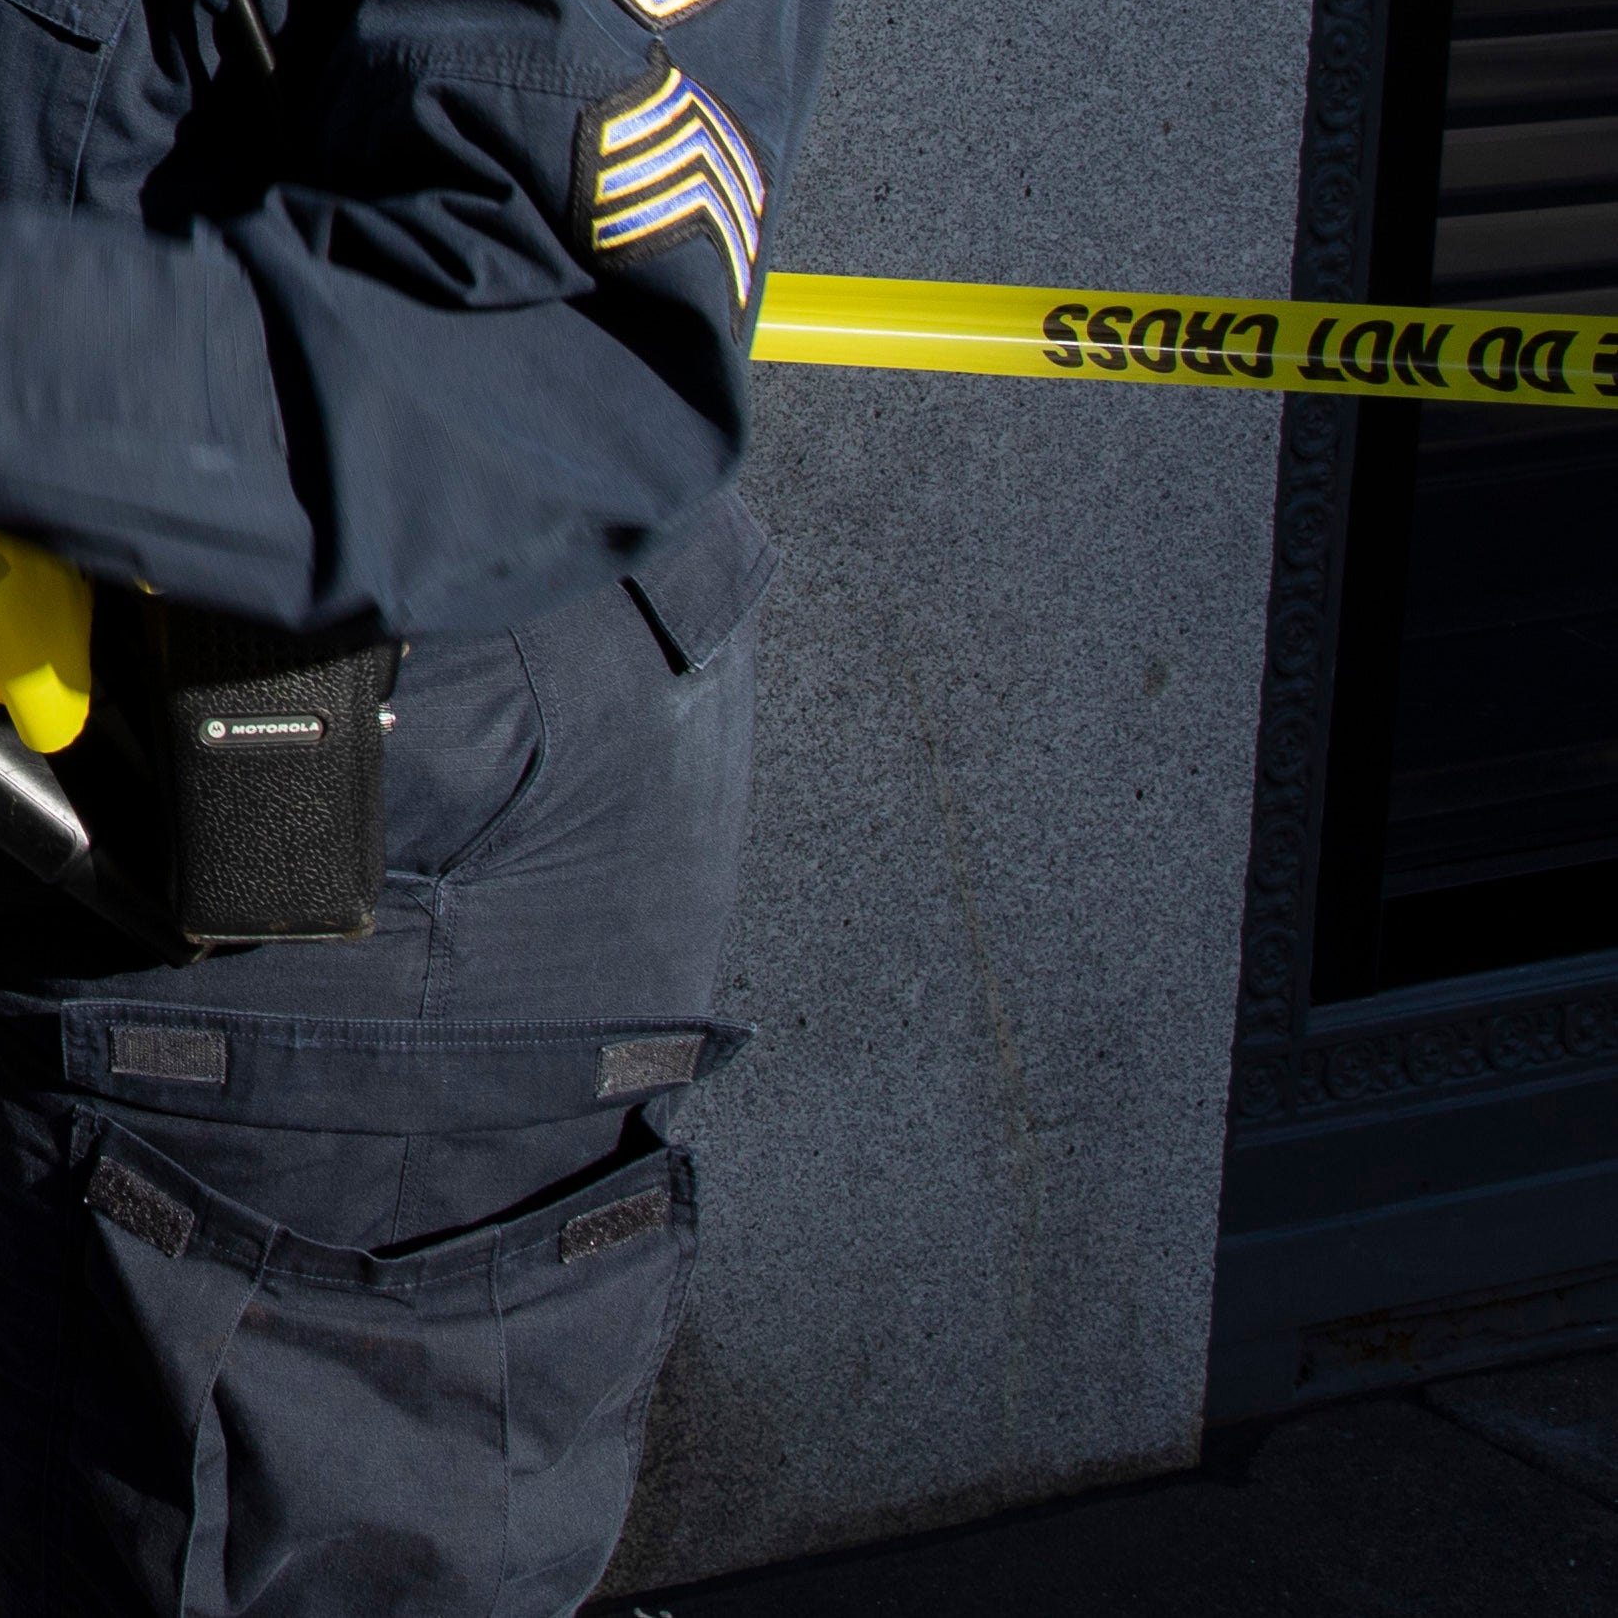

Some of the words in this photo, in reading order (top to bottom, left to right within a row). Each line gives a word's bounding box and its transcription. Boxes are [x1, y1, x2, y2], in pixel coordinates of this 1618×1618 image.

[1041, 302, 1280, 379] CROSS
[1297, 317, 1456, 388] NOT
[1466, 326, 1581, 395] DO
[231, 721, 320, 735] MOTOROLA
